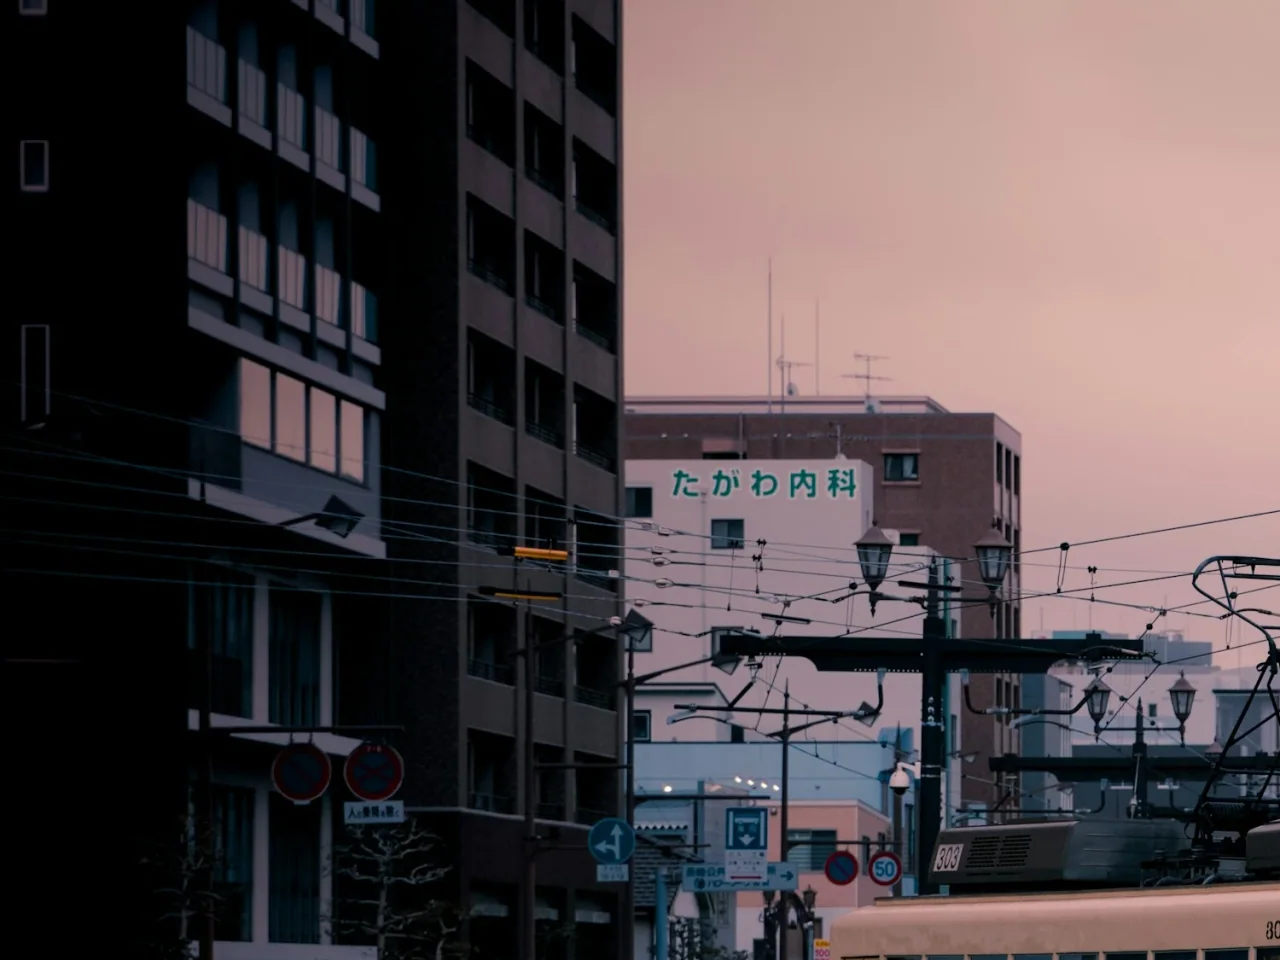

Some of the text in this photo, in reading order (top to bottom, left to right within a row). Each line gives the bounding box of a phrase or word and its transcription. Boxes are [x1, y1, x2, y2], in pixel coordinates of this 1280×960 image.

[672, 469, 857, 498] たがわ内科
[875, 860, 895, 877] 50
[936, 847, 960, 870] 303
